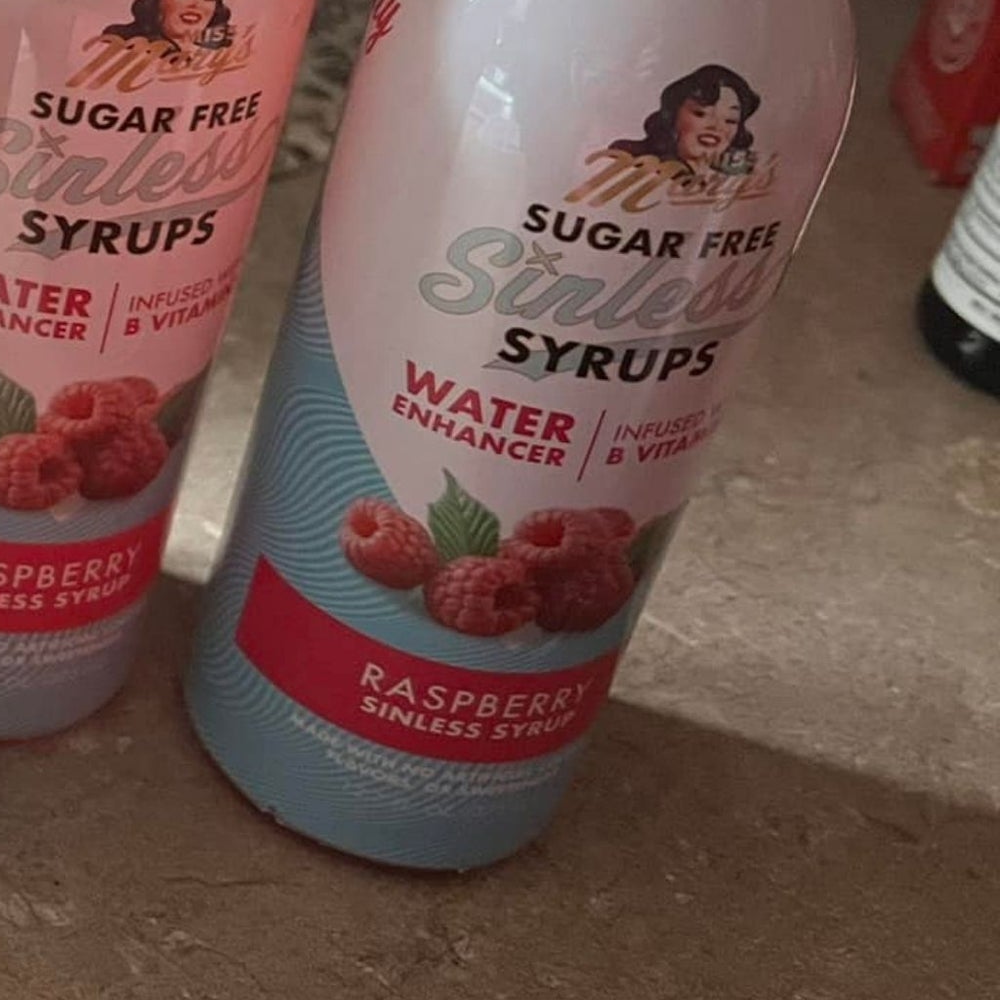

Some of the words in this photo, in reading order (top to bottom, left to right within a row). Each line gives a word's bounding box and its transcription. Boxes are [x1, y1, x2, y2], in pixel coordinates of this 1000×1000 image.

[30, 91, 176, 134] SUGAR
[189, 90, 263, 133] FREE
[17, 210, 218, 255] SYRUPS
[523, 203, 686, 260] SUGAR
[698, 220, 782, 260] FREE
[129, 279, 214, 313] INFUSED
[418, 226, 781, 331] Sinless
[124, 318, 140, 337] B
[497, 327, 721, 384] SYRUPS
[404, 359, 577, 444] WATER
[392, 393, 567, 468] ENHANCER
[606, 447, 625, 465] B
[53, 574, 131, 609] SYRUP
[360, 662, 595, 718] RASPBERRY
[360, 695, 482, 739] SINLESS
[491, 710, 578, 740] SYRUP
